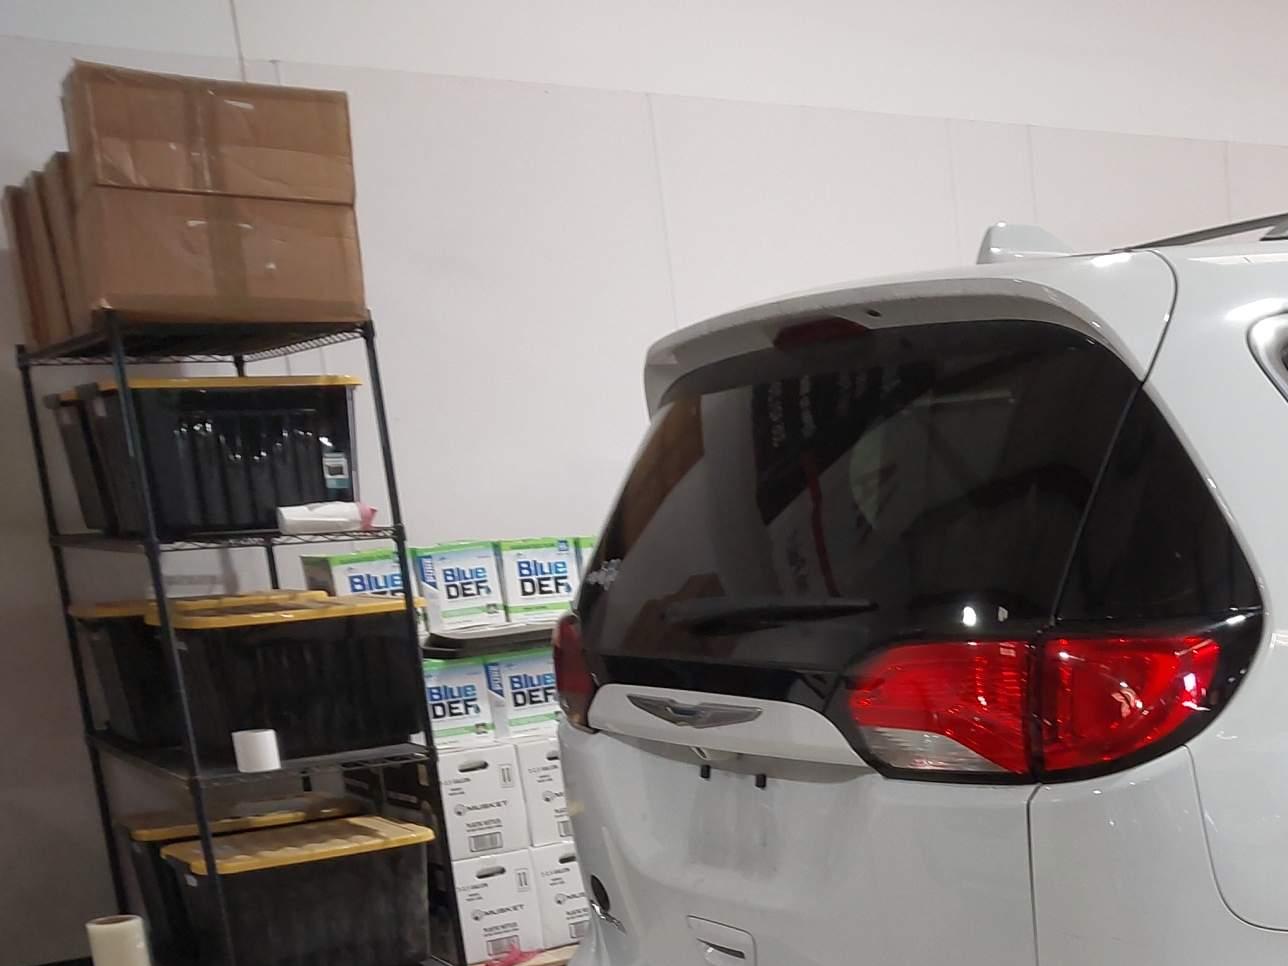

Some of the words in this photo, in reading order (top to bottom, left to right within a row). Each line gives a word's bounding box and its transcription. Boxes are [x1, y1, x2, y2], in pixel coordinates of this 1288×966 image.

[442, 567, 487, 582] Blue
[517, 560, 568, 577] Blue
[348, 573, 402, 593] Blue
[446, 580, 488, 599] DEF
[519, 576, 568, 596] DEF
[510, 673, 556, 690] Blue
[427, 684, 476, 701] Blue
[513, 687, 555, 707] DEF
[432, 698, 478, 719] DEF
